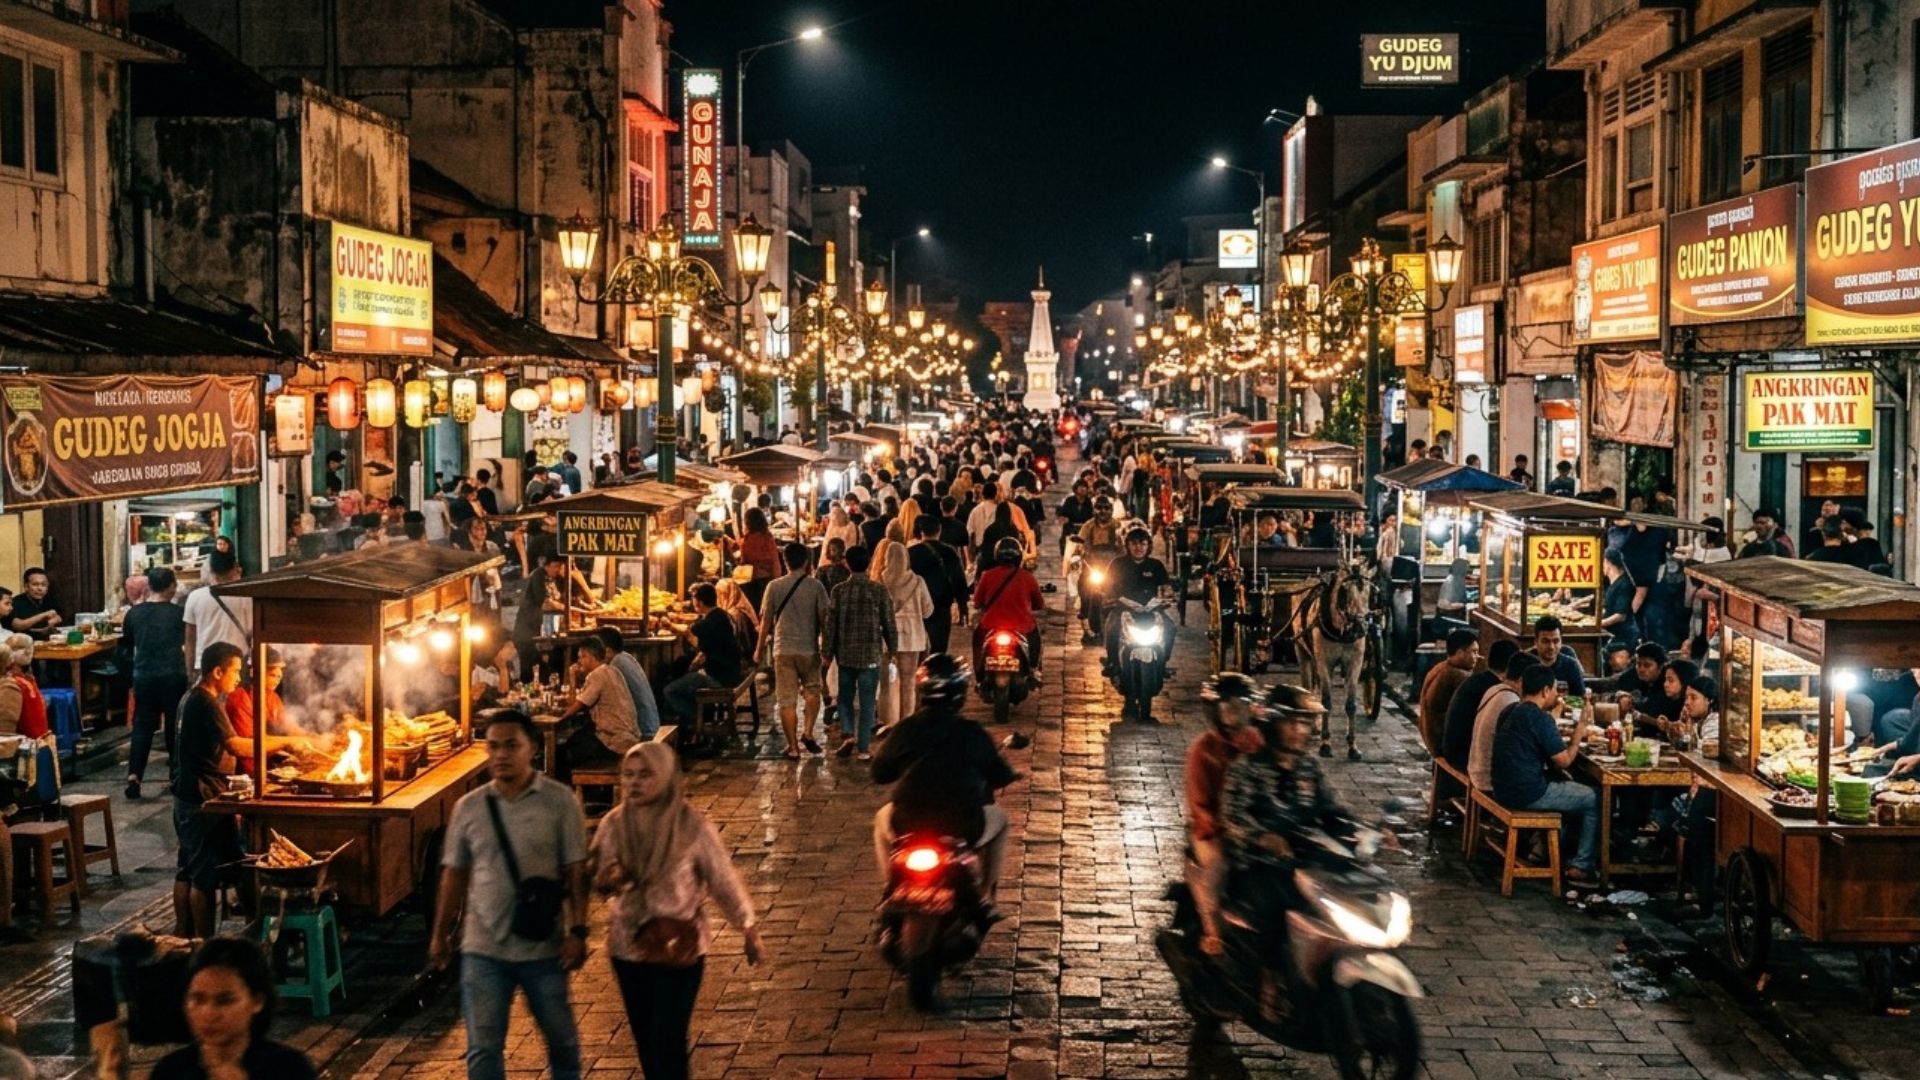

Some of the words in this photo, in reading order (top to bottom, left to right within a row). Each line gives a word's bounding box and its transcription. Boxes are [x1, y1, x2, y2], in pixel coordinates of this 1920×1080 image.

[1379, 38, 1442, 53] GUDEG
[1369, 55, 1396, 71] YU
[1402, 55, 1452, 74] DJUM
[692, 102, 713, 230] GUNAJA
[1816, 202, 1892, 260] GUDEG
[1899, 197, 1920, 247] Y
[1729, 225, 1787, 272] PAWON
[336, 236, 384, 282] GUDEG
[387, 247, 428, 288] JOGJA
[1752, 377, 1868, 397] ANGKRINGAN
[1762, 403, 1806, 425] PAK
[1813, 402, 1858, 424] MAT
[53, 414, 148, 461] GUDEG
[153, 411, 227, 453] JOGJA
[567, 532, 599, 551] PAK
[604, 533, 637, 551] MAT
[1537, 541, 1592, 559] SATE
[1534, 564, 1594, 582] AYAM
